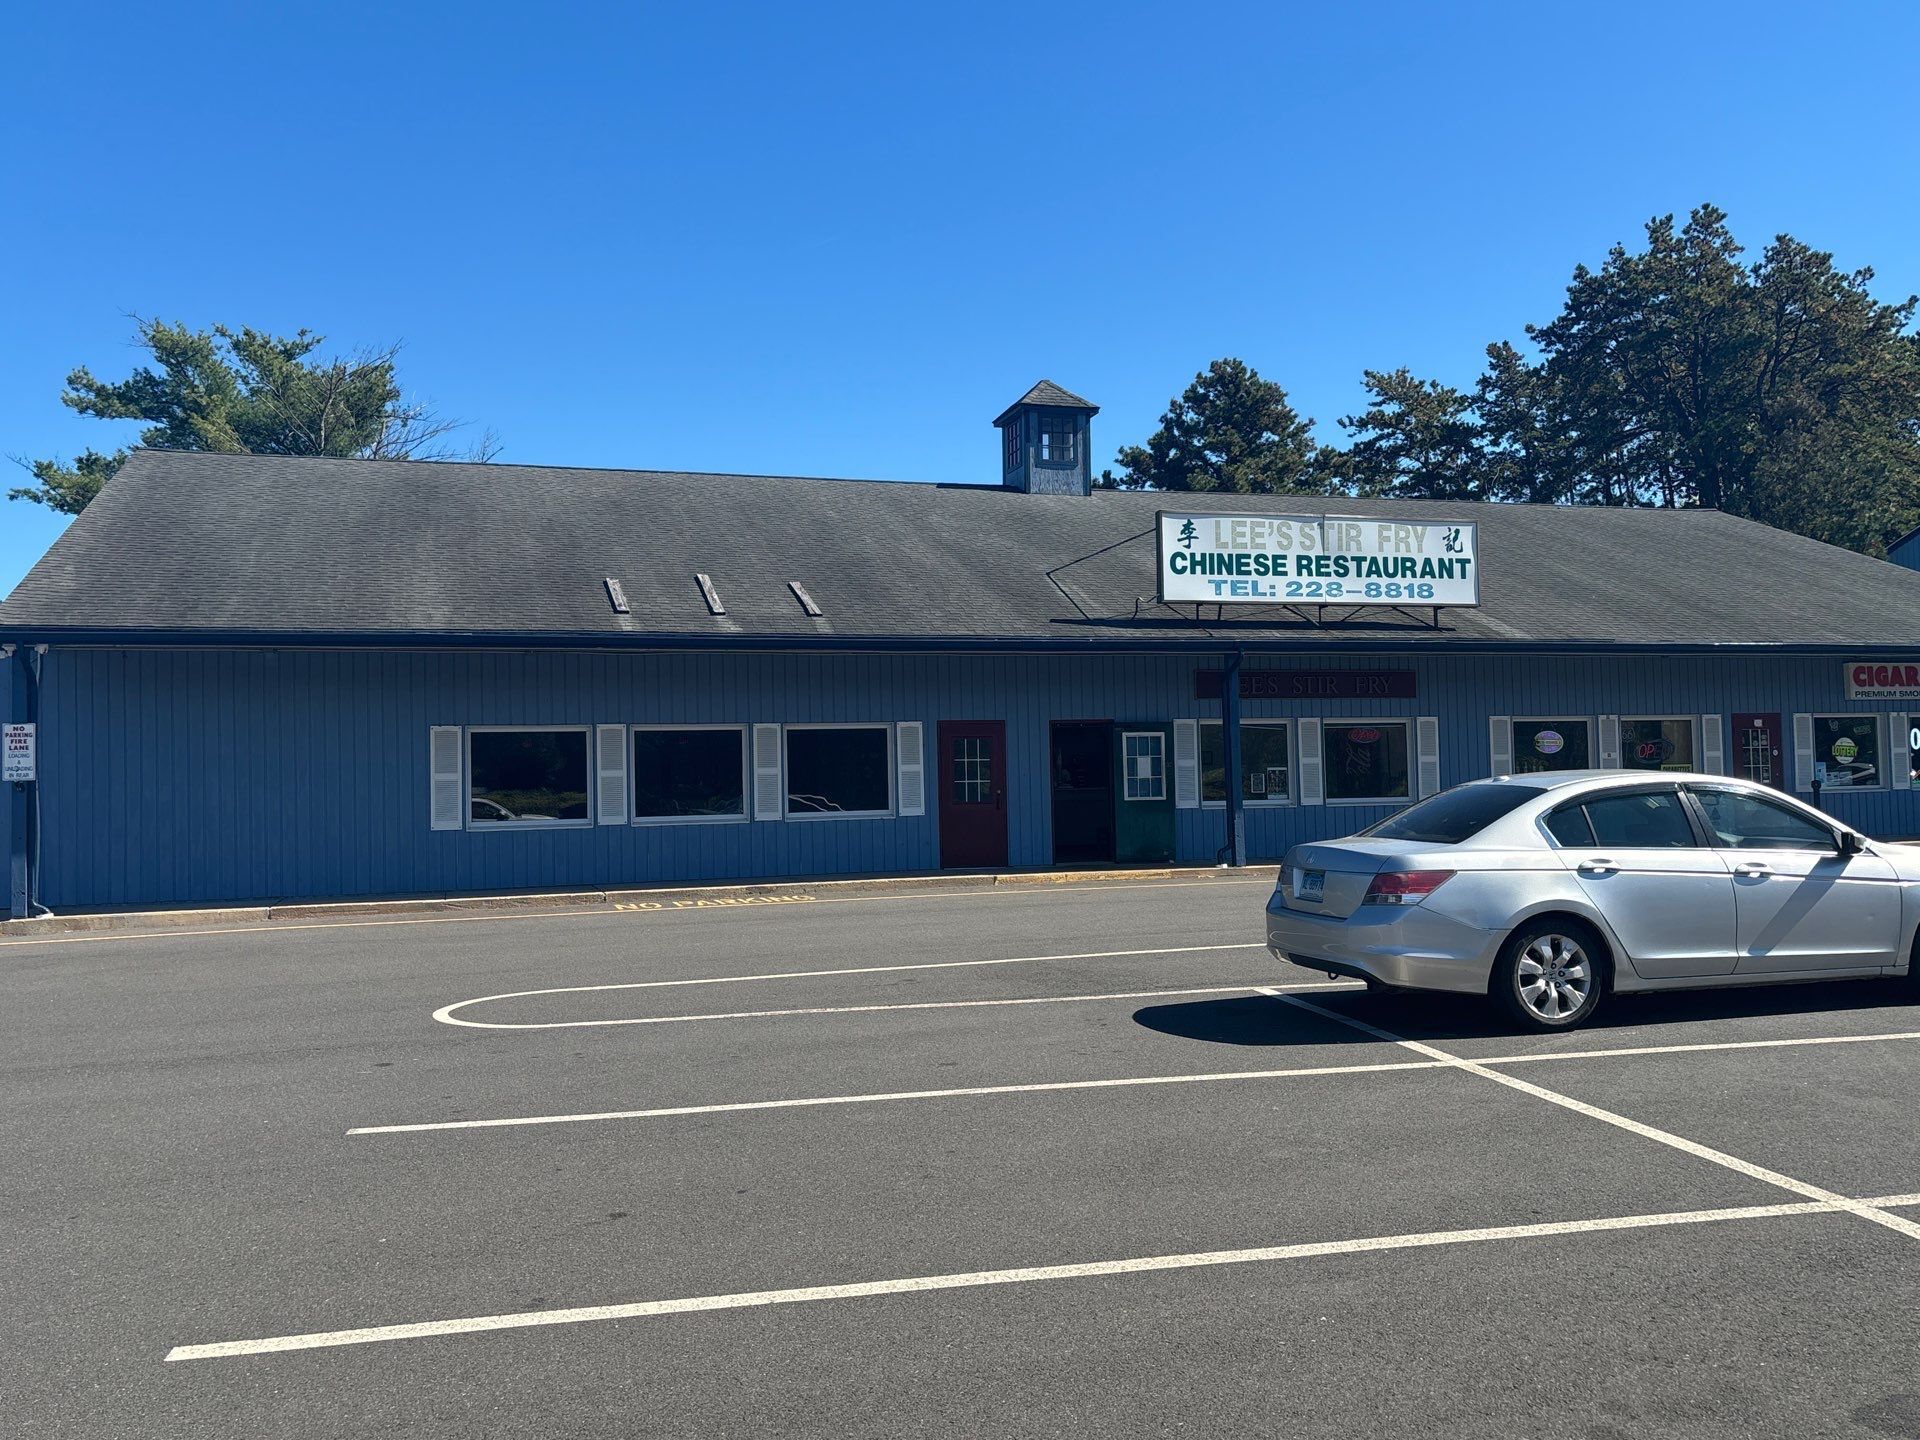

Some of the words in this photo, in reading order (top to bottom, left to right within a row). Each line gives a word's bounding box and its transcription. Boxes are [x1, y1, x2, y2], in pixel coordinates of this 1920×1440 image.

[1177, 518, 1199, 549] 李
[1214, 519, 1293, 551] LEE'S
[1299, 522, 1362, 552] STIR
[1377, 523, 1428, 553] FRY
[1169, 551, 1288, 577] CHINESE
[1296, 554, 1471, 580] RESTAURANT
[1208, 579, 1276, 597] TEL:
[1285, 580, 1434, 599] 228-8818
[1239, 676, 1278, 694] EE'S
[1293, 676, 1339, 695] STIR
[1355, 676, 1392, 694] FRY
[1855, 690, 1896, 698] PREMIUM
[1898, 690, 1920, 698] SMO
[1832, 745, 1859, 757] LOTTERY
[614, 902, 663, 911] NO
[672, 895, 816, 907] PARKING
